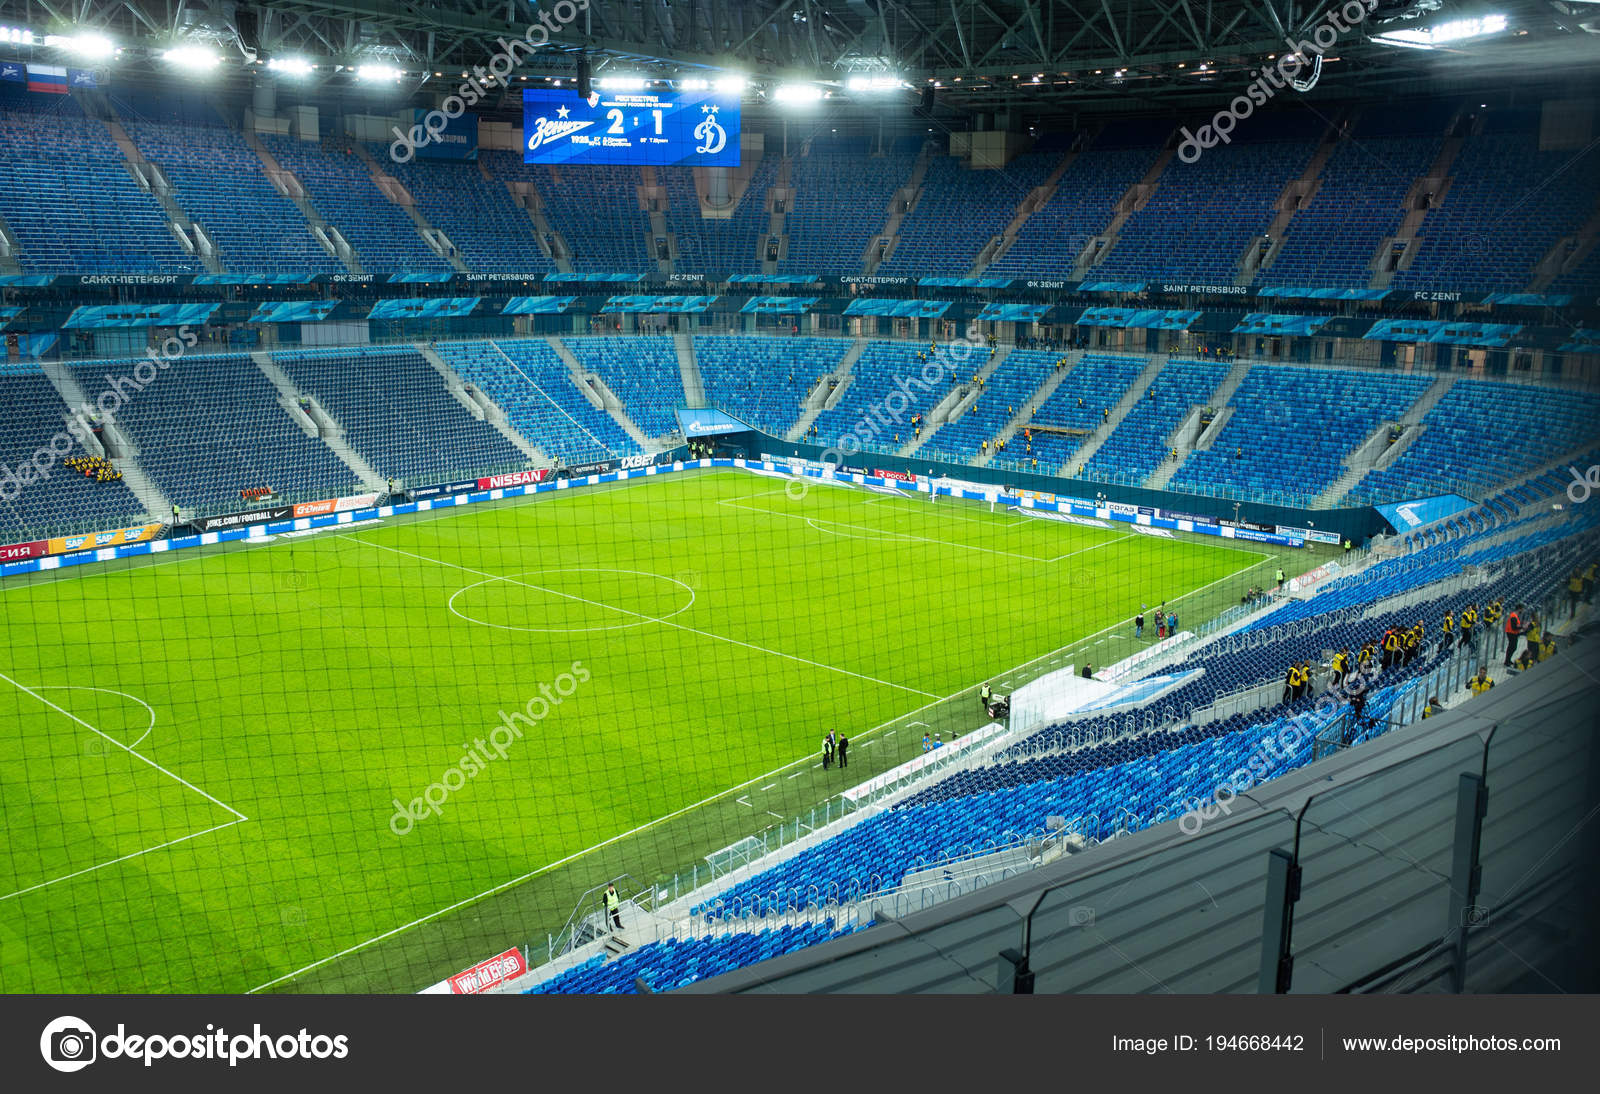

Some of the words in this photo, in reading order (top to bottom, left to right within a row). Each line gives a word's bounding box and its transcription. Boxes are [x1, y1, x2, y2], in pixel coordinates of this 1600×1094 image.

[607, 108, 624, 134] 2
[652, 110, 662, 134] 1
[80, 275, 178, 285] САНКТ-ПЕТЕРБУРГ
[333, 274, 348, 282] ФК
[348, 274, 374, 282] ЗЕНИТ
[466, 273, 487, 281] SAINT
[488, 273, 535, 281] PETERSBURG
[670, 273, 680, 281] FC
[682, 273, 704, 282] ZENIT
[840, 275, 908, 285] САНКТ-ПЕТЕРБУРГ
[1027, 280, 1039, 288] ФК
[1039, 281, 1064, 289] ЗЕНИТ
[1163, 284, 1188, 293] SAINT
[1190, 285, 1247, 295] PETERSBURG
[1415, 291, 1429, 300] FC
[1431, 292, 1461, 301] ZENIT
[621, 454, 656, 469] 1XBET
[490, 471, 541, 488] NISSAN
[886, 472, 913, 481] РОСС
[1109, 503, 1134, 513] СОГАЗ
[65, 539, 83, 550] SAP
[95, 534, 113, 544] SAP
[124, 530, 142, 540] SAP
[459, 968, 489, 993] World
[489, 956, 518, 983] Class
